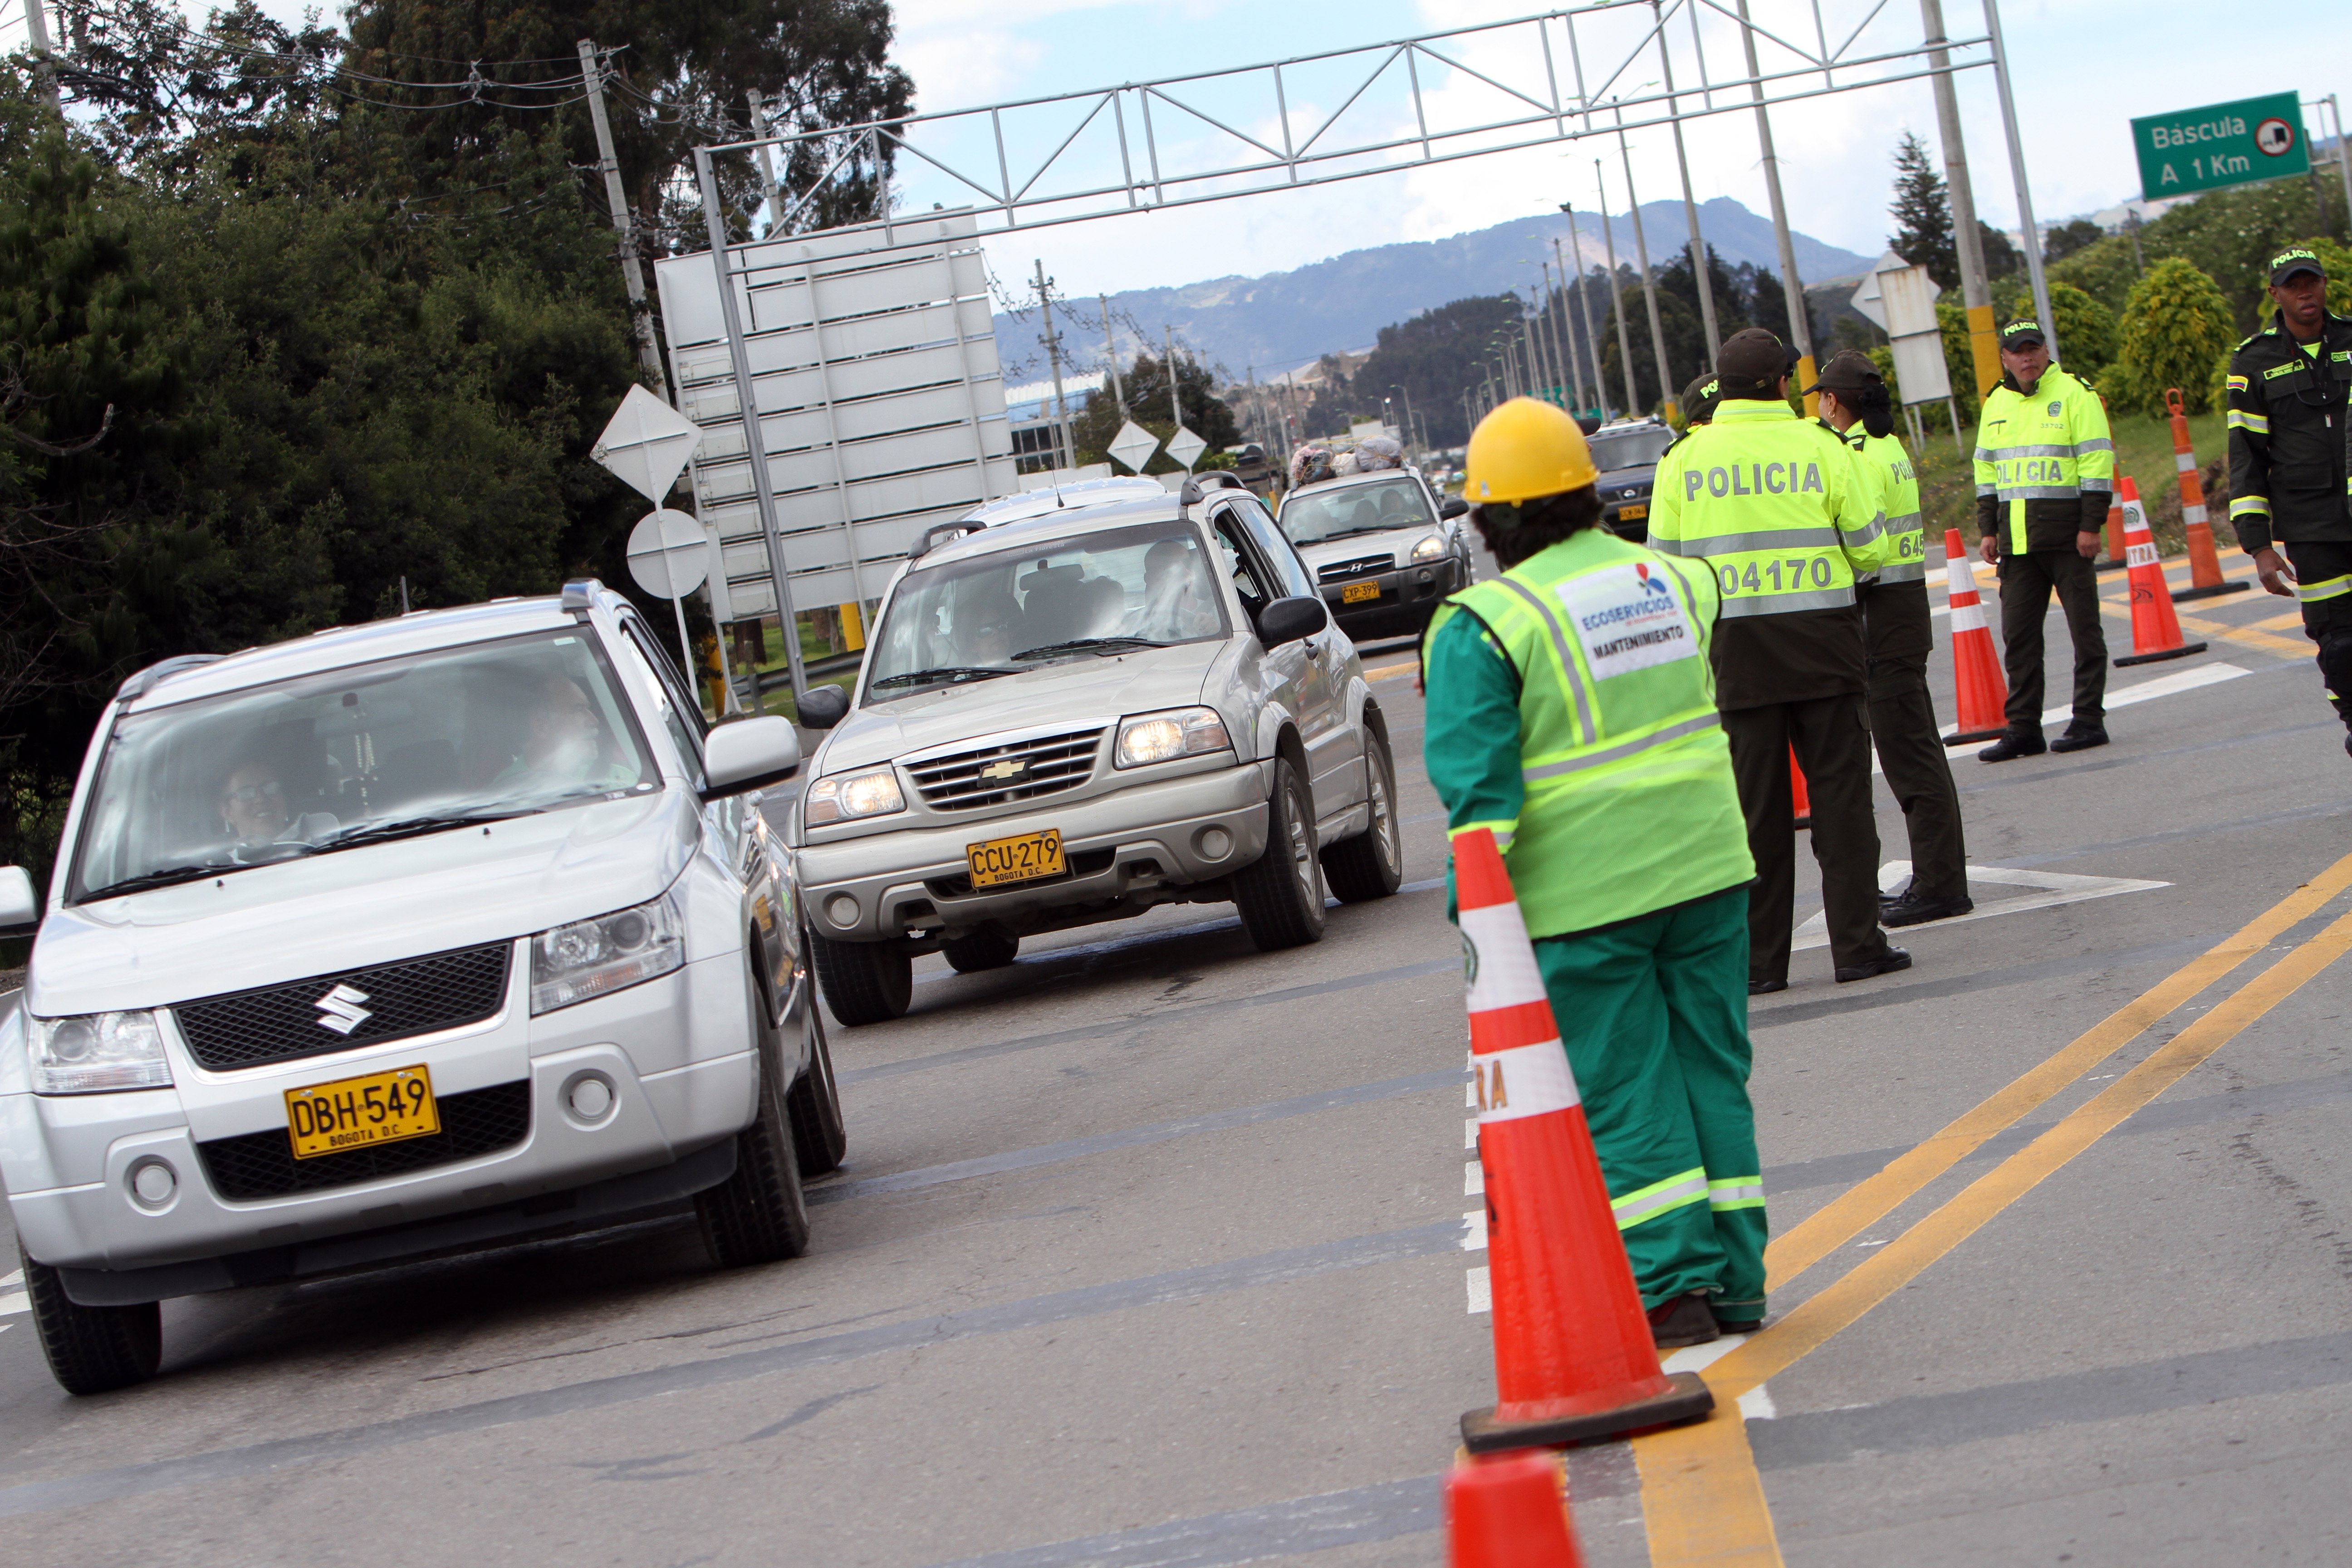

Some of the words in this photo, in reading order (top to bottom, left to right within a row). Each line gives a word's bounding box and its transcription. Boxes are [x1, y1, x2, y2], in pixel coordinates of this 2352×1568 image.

[2151, 116, 2246, 149] Báscula
[2161, 163, 2179, 185] A
[2192, 158, 2203, 179] 1
[2211, 153, 2251, 176] Km
[2272, 249, 2317, 269] POLICIA
[2004, 321, 2039, 337] POLICIA
[1684, 462, 1824, 502] POLICIA
[1719, 557, 1832, 595] 04170
[1582, 596, 1674, 631] ECOSERVICIOS
[1593, 626, 1684, 660] MANTENIMIENTO
[994, 872, 1024, 882] BOGOTA
[1028, 867, 1043, 876] D.C.
[329, 1129, 375, 1146] BOGOTA
[382, 1124, 403, 1137] D.C.
